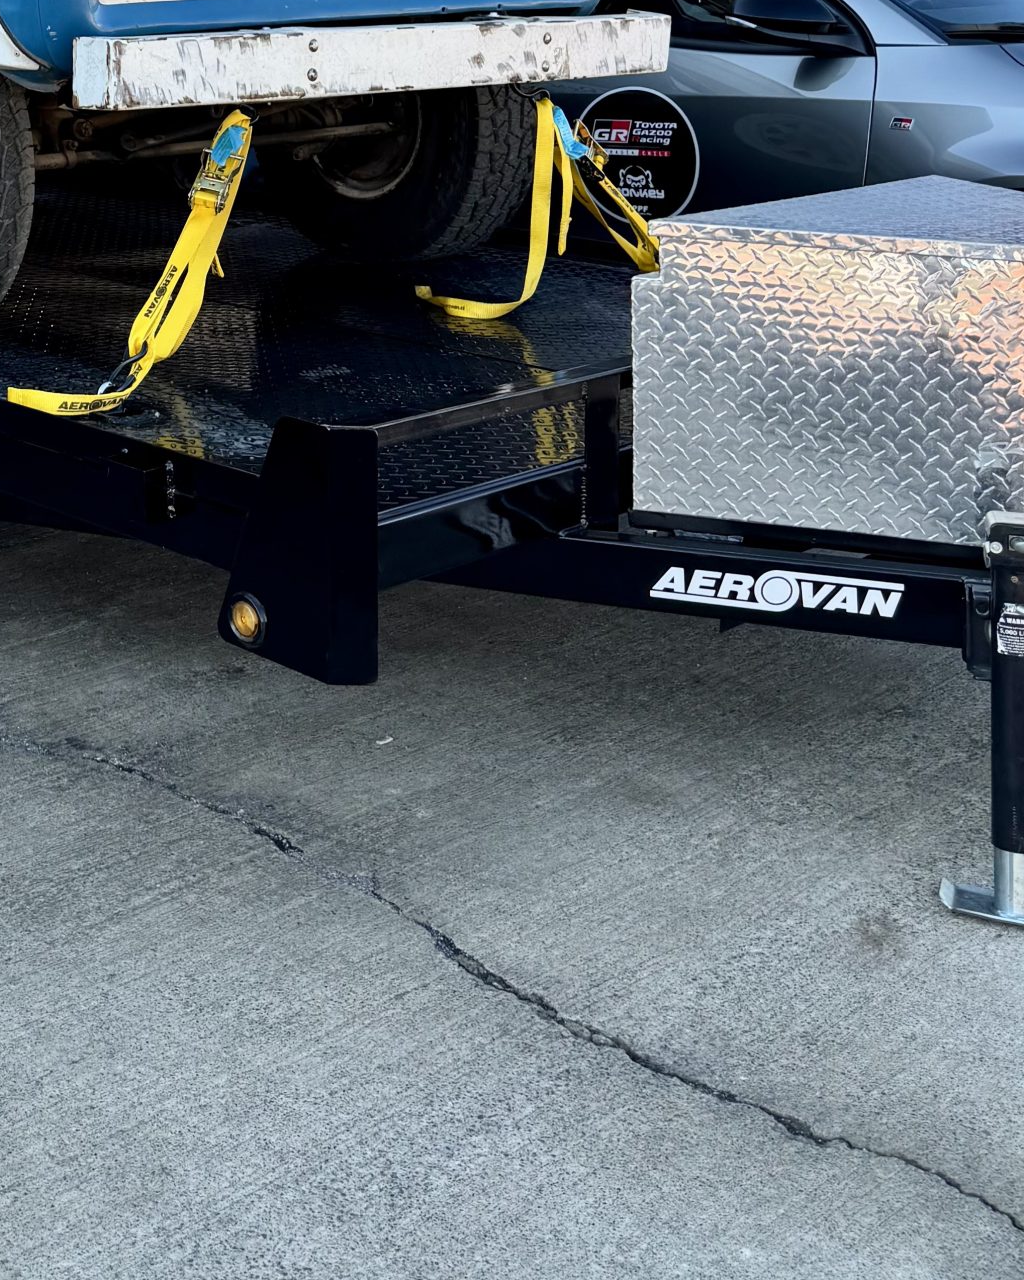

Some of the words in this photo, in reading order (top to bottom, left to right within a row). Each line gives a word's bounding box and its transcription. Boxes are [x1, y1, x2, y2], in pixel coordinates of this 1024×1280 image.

[634, 121, 678, 129] TOYOTA
[594, 128, 628, 142] GR
[632, 136, 671, 146] Racing
[143, 265, 178, 318] AEROVAN
[650, 566, 905, 618] AEROVAN
